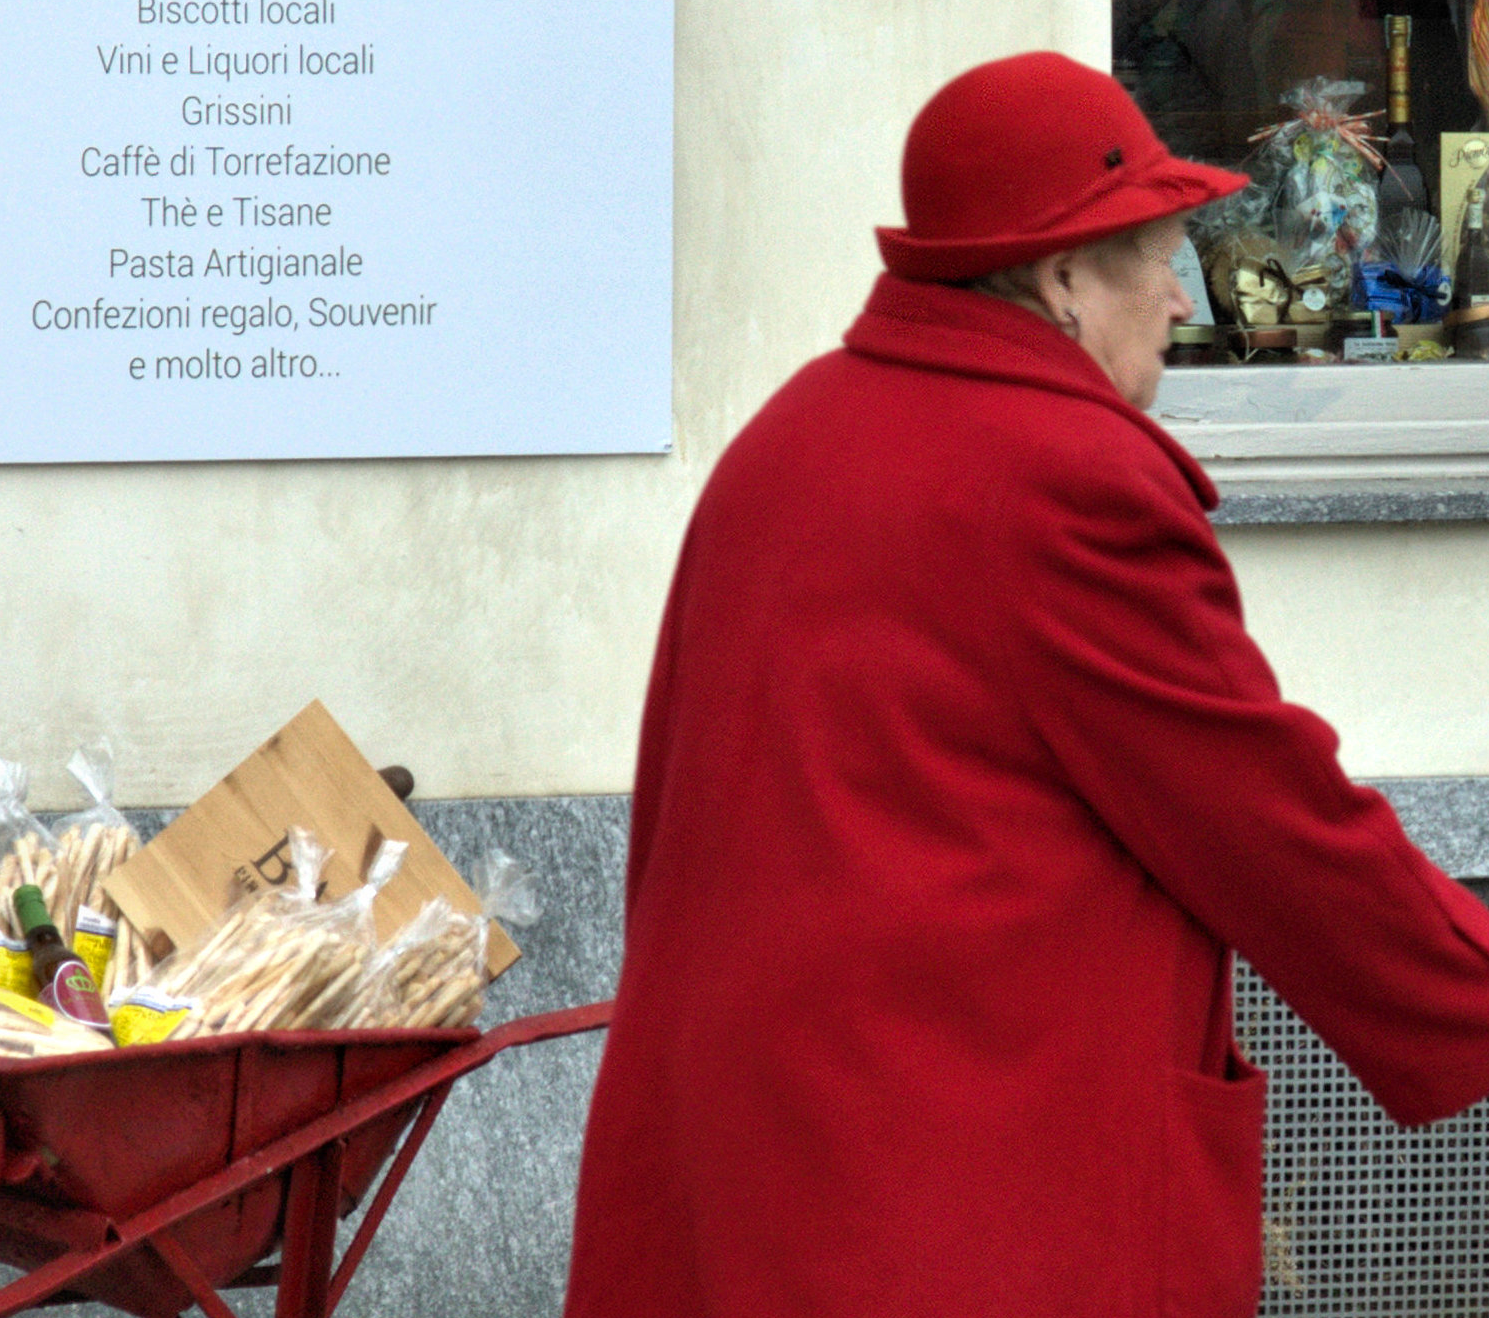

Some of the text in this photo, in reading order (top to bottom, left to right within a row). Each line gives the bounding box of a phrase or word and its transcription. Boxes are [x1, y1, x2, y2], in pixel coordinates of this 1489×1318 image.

[96, 43, 374, 83] Vini e Liquori locali
[181, 95, 292, 127] Grissini
[80, 143, 392, 178] Caffè di Torrefazione
[140, 195, 333, 228] Thè e Tisane
[109, 244, 364, 286] Pasta Artigianale
[31, 294, 438, 337] Confezioni regalo, Souvenir
[128, 346, 341, 381] e molto altro...
